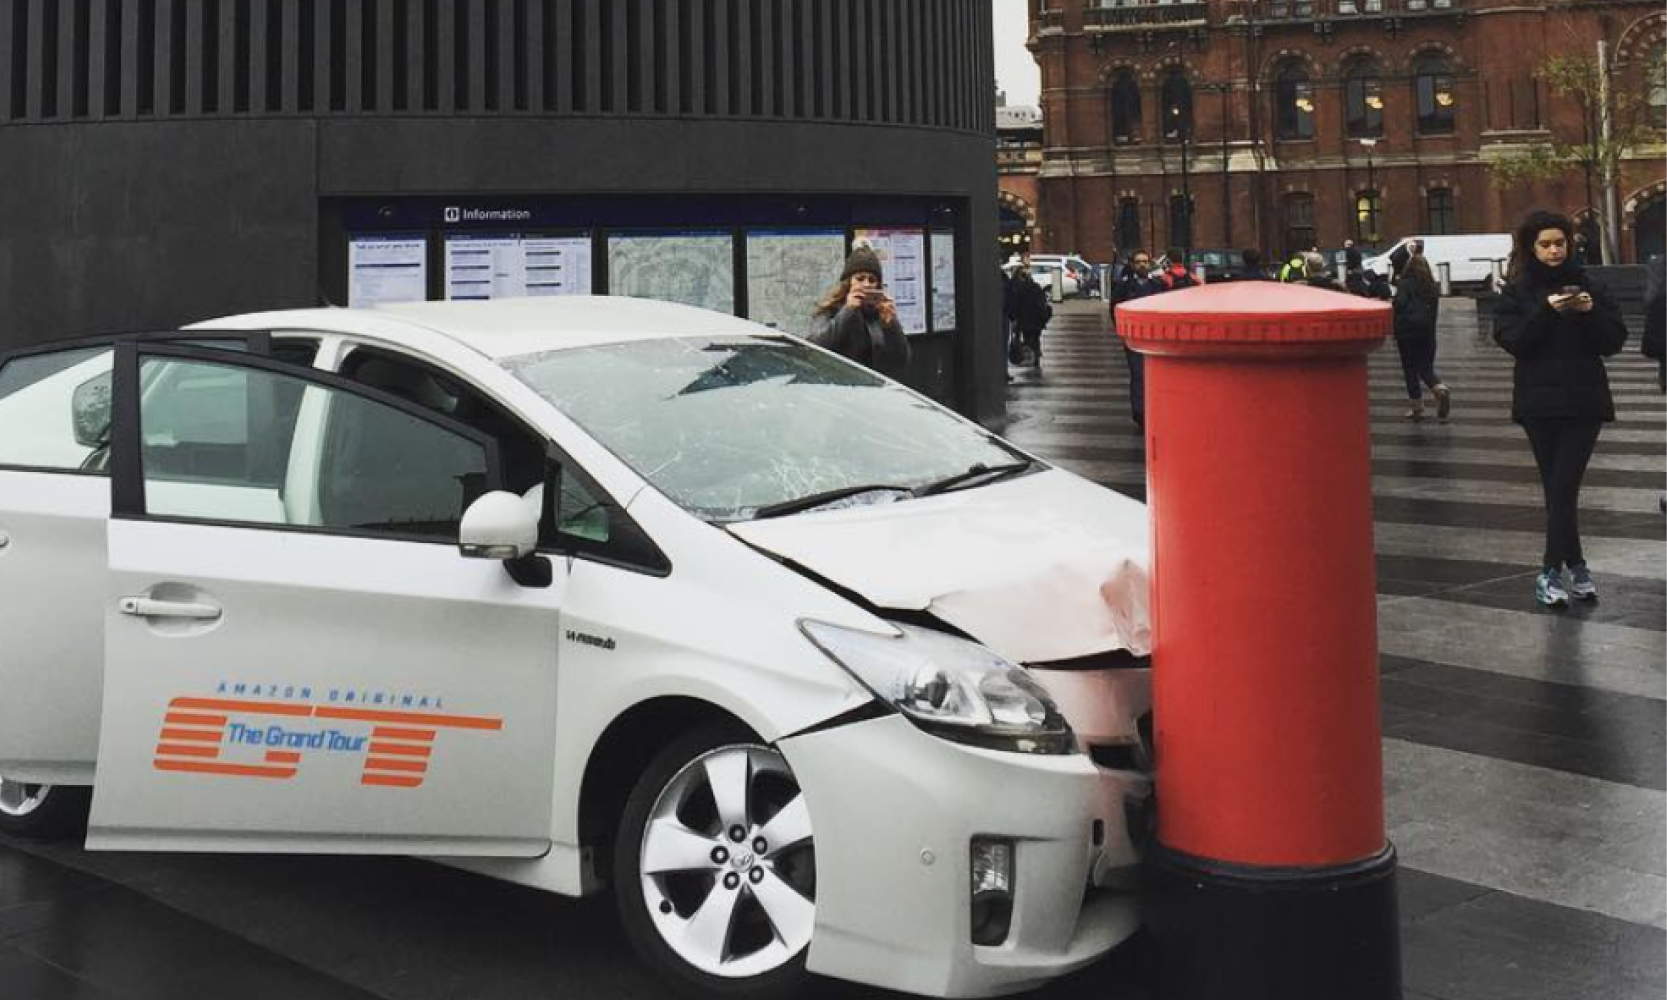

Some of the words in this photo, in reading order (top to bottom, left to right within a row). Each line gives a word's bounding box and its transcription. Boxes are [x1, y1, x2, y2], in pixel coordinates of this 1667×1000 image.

[464, 208, 531, 220] Information
[217, 682, 311, 699] AMAZON
[329, 689, 443, 708] ORIGINAL
[229, 723, 263, 744] The
[266, 725, 325, 748] Grand
[327, 730, 367, 751] Tour
